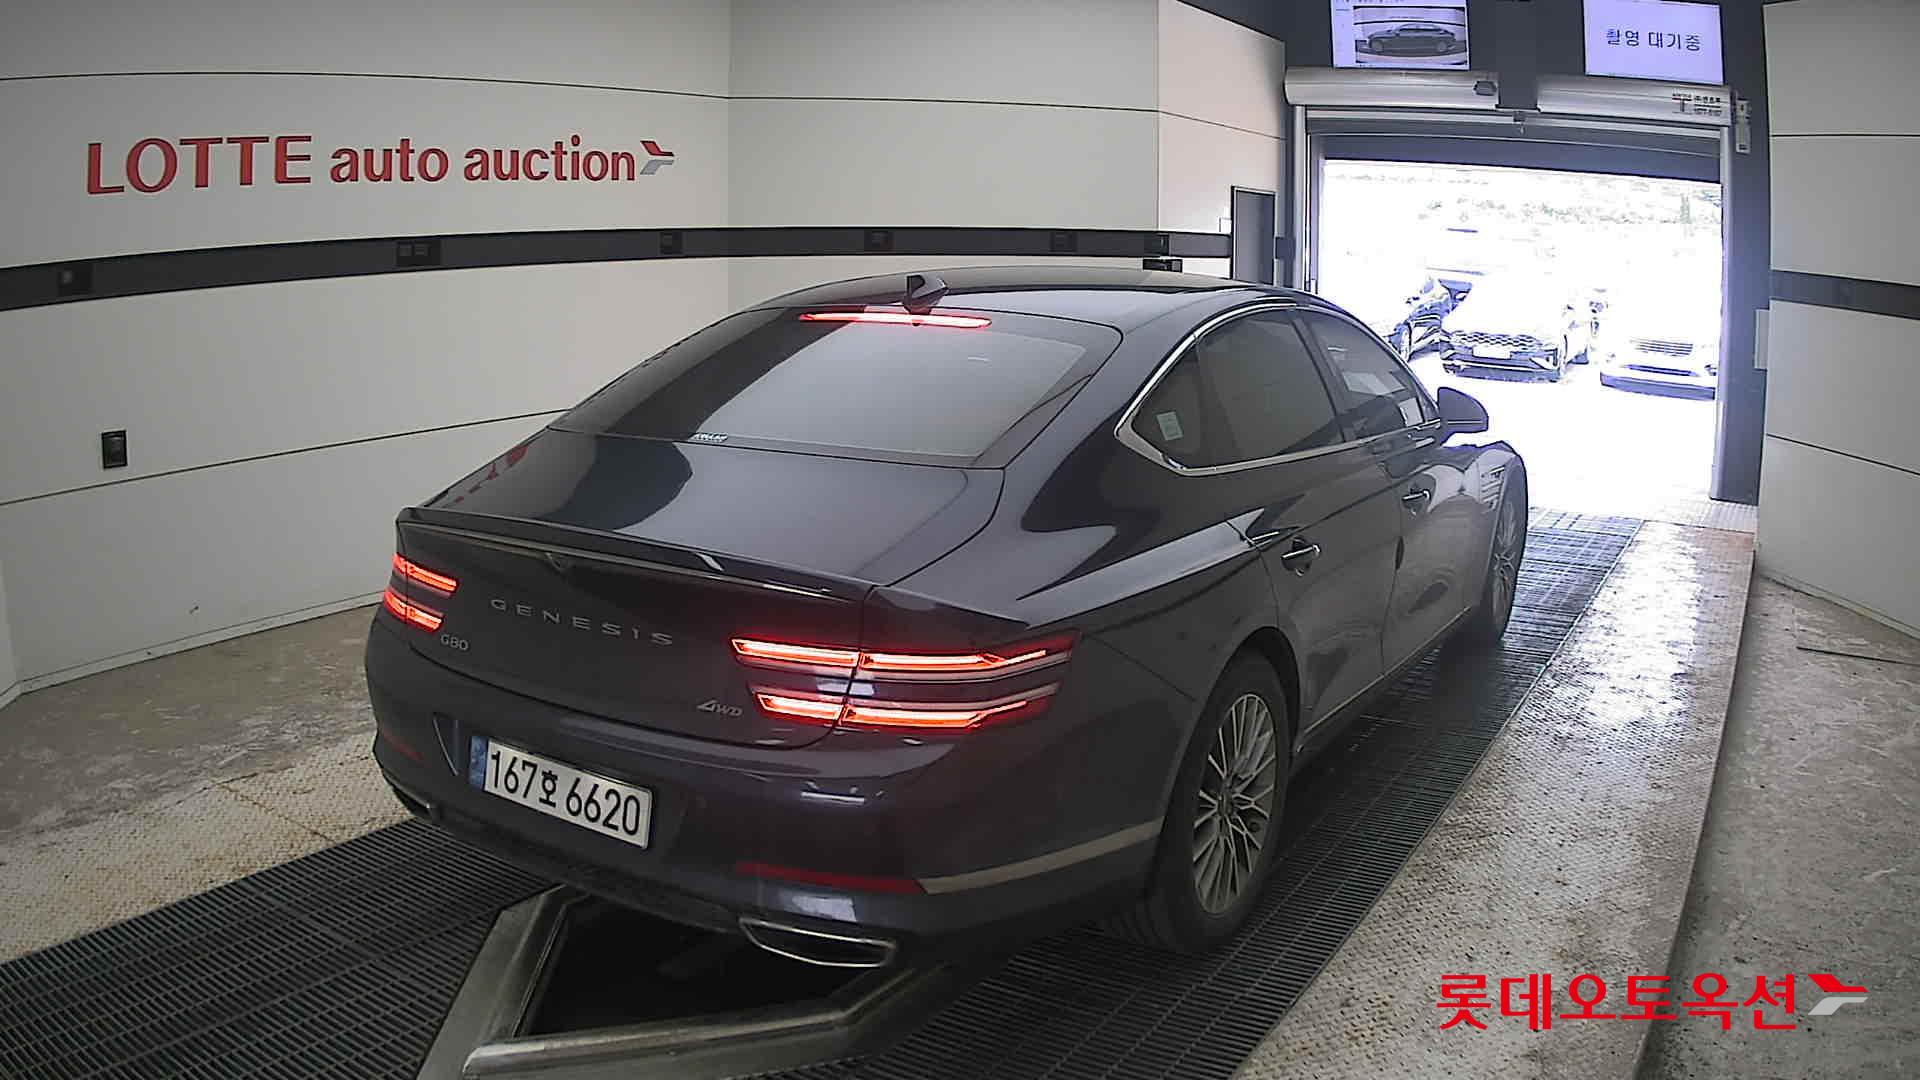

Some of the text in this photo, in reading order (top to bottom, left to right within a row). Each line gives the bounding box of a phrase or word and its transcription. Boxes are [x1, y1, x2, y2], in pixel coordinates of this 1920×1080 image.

[1648, 31, 1701, 52] 대기중
[86, 134, 637, 195] LOTTE auto auction
[490, 598, 674, 647] GENESIS
[440, 633, 470, 651] G80
[696, 699, 744, 717] 4WD
[491, 750, 641, 836] 167호 6620
